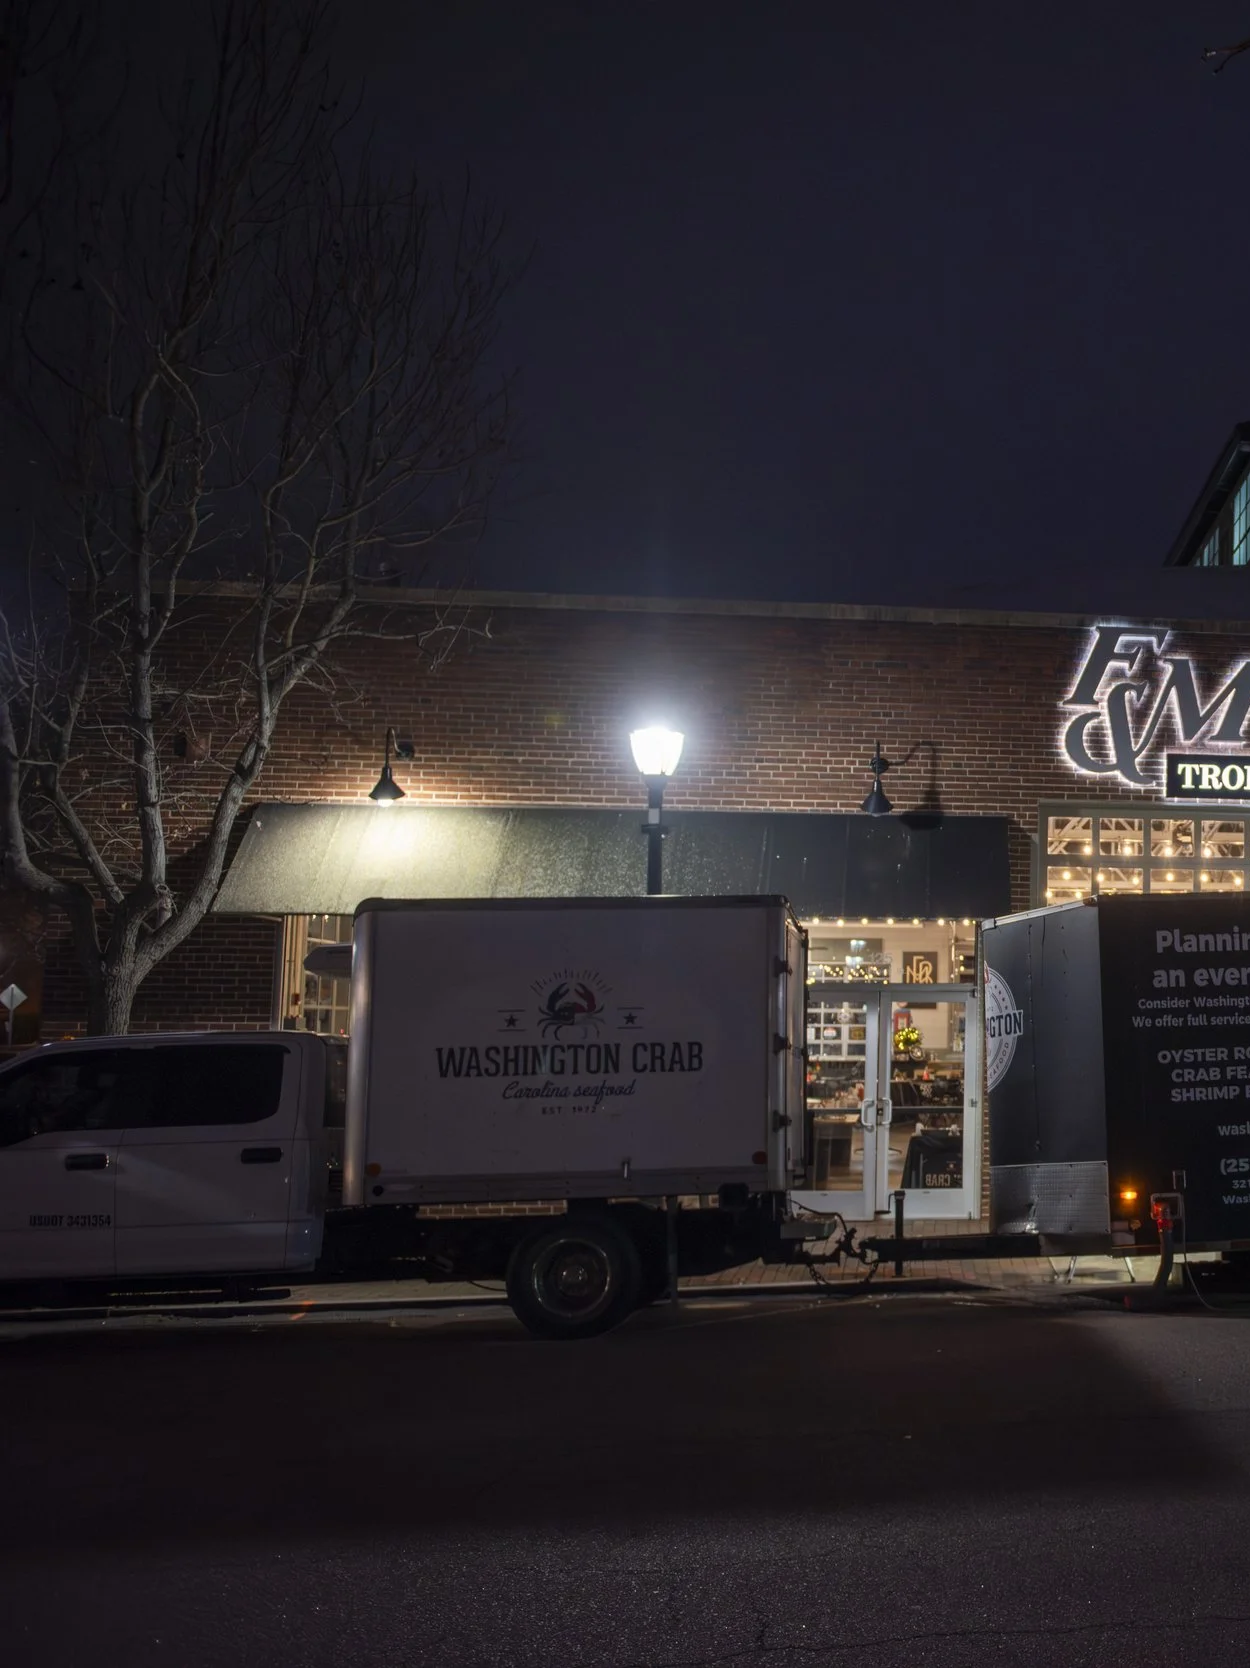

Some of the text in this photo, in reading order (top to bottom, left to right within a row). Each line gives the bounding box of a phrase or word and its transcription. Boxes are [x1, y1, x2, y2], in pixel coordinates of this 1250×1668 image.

[1152, 968, 1186, 988] an
[1138, 997, 1190, 1009] Consider
[986, 1011, 1022, 1038] GTON
[1132, 1016, 1152, 1028] We
[1155, 1014, 1183, 1027] offer
[1187, 1013, 1208, 1026] full
[436, 1041, 704, 1078] WASHINGTON CRAB
[1157, 1048, 1228, 1064] OYSTER
[1171, 1067, 1221, 1083] CRAB
[502, 1079, 636, 1105] Carolina seafood
[1170, 1086, 1240, 1102] SHRIMP
